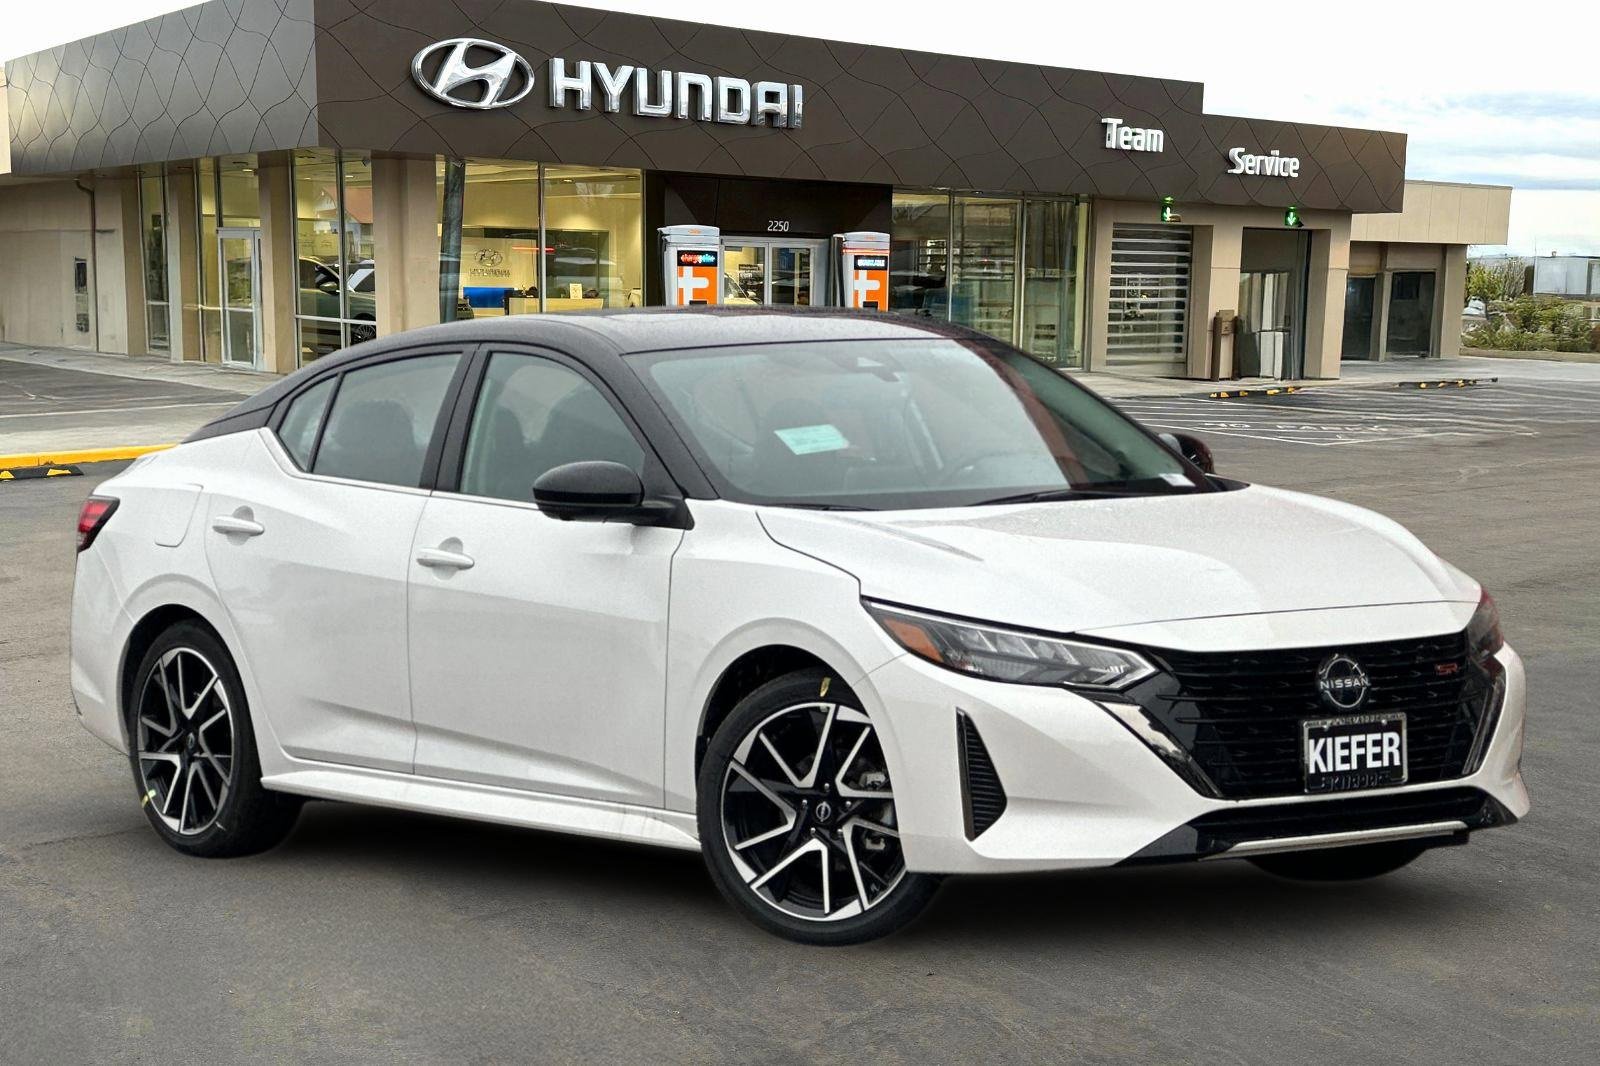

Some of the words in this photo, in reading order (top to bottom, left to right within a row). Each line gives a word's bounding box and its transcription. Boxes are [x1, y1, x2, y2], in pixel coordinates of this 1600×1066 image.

[548, 57, 803, 129] HYUNDAI
[1101, 117, 1164, 153] Team
[1227, 147, 1300, 178] Service
[767, 220, 790, 232] 2250
[1320, 677, 1371, 690] NISSAN
[1308, 731, 1401, 774] KIEFER
